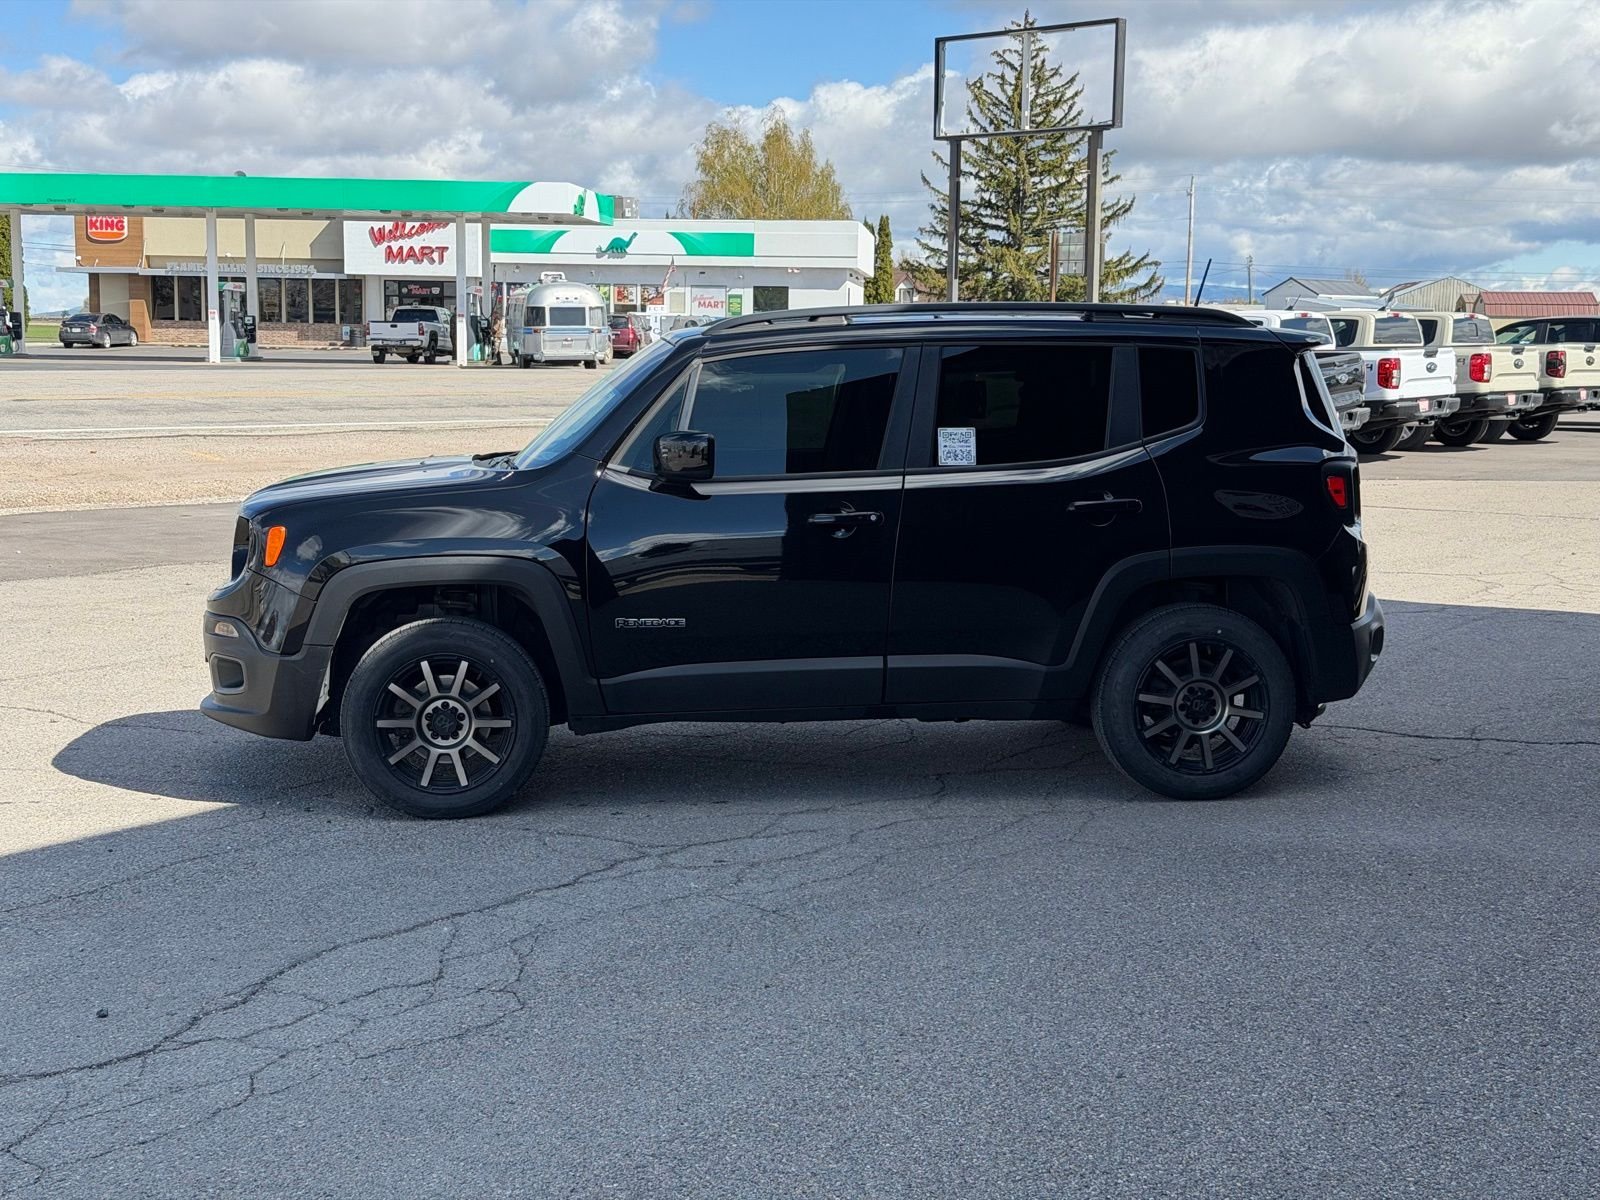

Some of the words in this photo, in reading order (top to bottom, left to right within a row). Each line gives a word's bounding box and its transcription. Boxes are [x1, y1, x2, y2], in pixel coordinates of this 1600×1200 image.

[89, 219, 125, 231] KING
[368, 220, 449, 247] Wellcom
[385, 245, 449, 265] MART
[257, 264, 289, 274] SINCE
[697, 300, 725, 309] MART
[615, 617, 686, 629] RENEGADE
